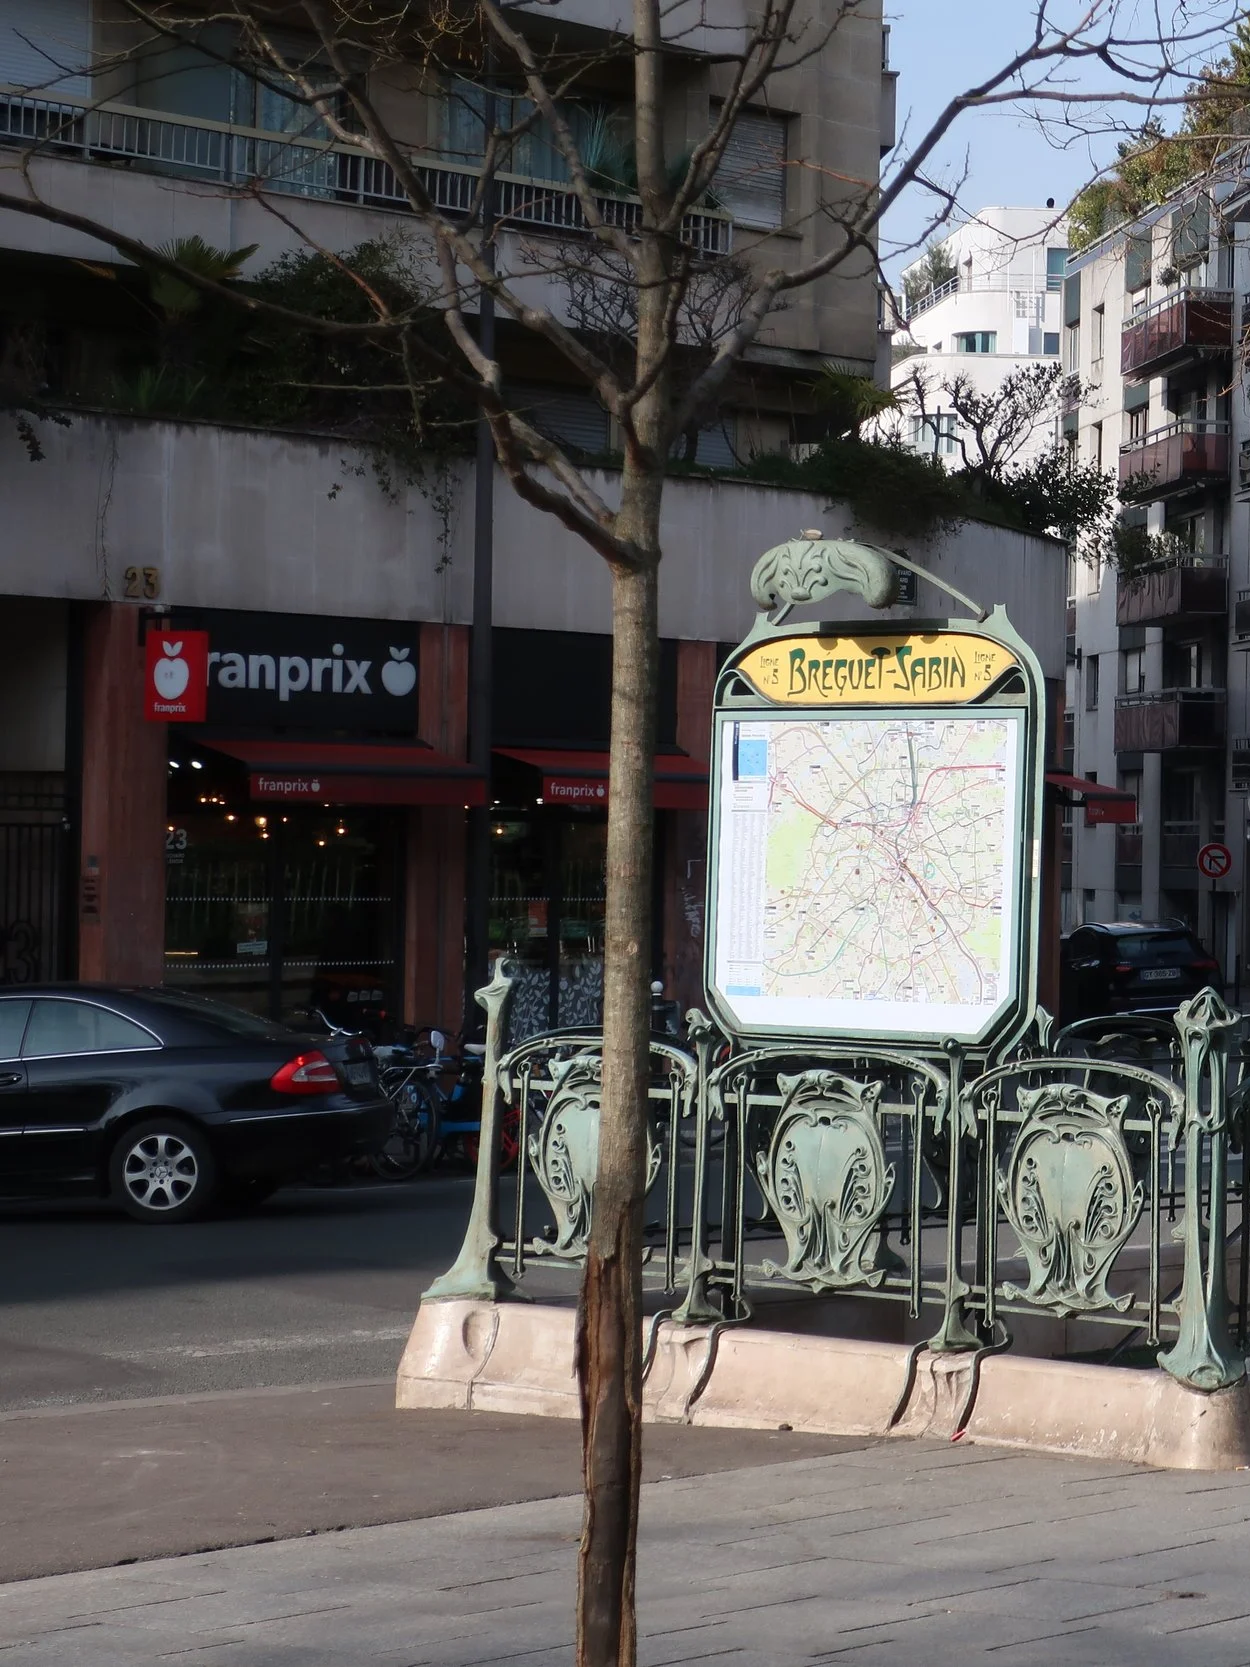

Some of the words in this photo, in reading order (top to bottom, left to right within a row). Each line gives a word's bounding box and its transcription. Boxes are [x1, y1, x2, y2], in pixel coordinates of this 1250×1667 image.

[124, 567, 161, 599] 23
[760, 656, 779, 668] LIGNE
[974, 651, 996, 663] LIGNE
[206, 643, 373, 702] ranprix
[154, 702, 186, 714] franprix
[258, 778, 308, 794] franprix
[551, 782, 594, 798] franprix
